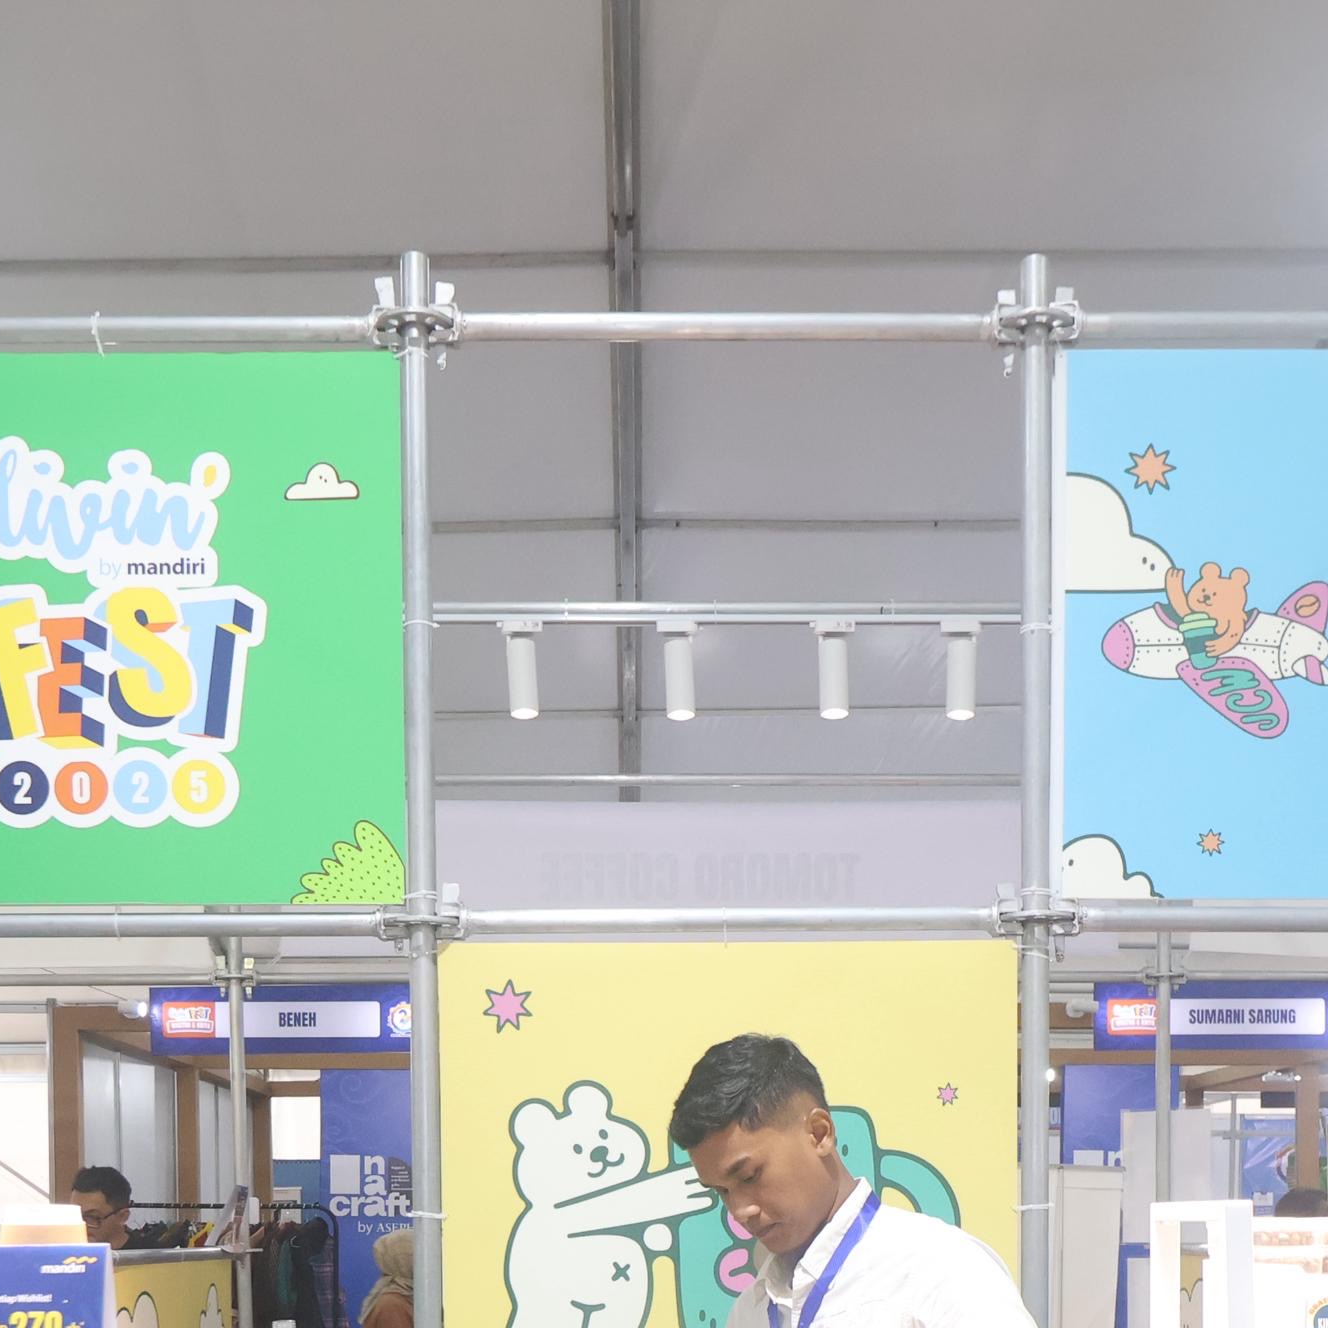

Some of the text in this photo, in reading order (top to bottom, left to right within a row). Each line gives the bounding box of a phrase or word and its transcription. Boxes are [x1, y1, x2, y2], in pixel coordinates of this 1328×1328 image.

[99, 557, 206, 580] by mandiri
[4, 764, 218, 811] 2025
[278, 1011, 317, 1028] BENEH
[1188, 1008, 1296, 1025] SUMARNI SARUNG
[329, 1192, 411, 1217] craft
[357, 1221, 374, 1236] by
